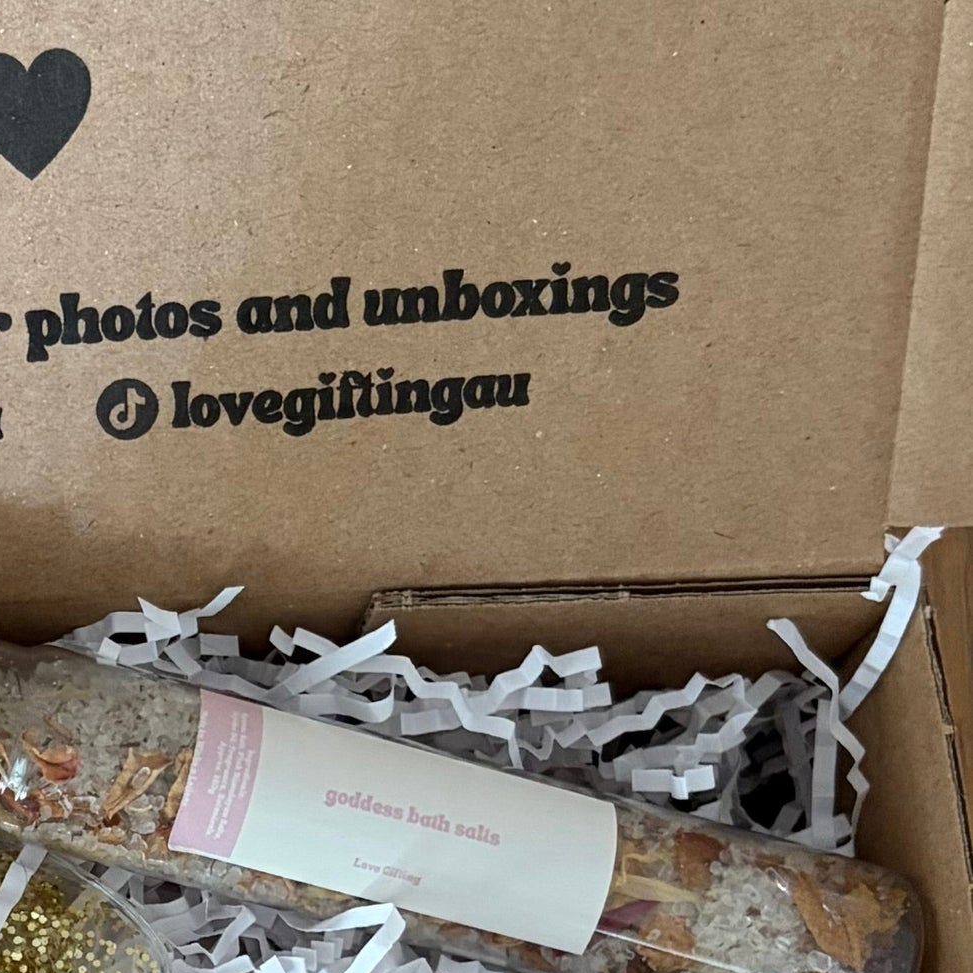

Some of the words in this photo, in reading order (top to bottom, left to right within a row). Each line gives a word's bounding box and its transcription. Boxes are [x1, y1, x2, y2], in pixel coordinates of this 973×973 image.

[25, 292, 223, 362] photos
[237, 277, 351, 334] and
[363, 262, 680, 327] unboxings
[171, 366, 532, 439] lovegiftingau
[324, 788, 403, 820] goddess
[406, 806, 450, 833] bath
[454, 824, 501, 846] salts
